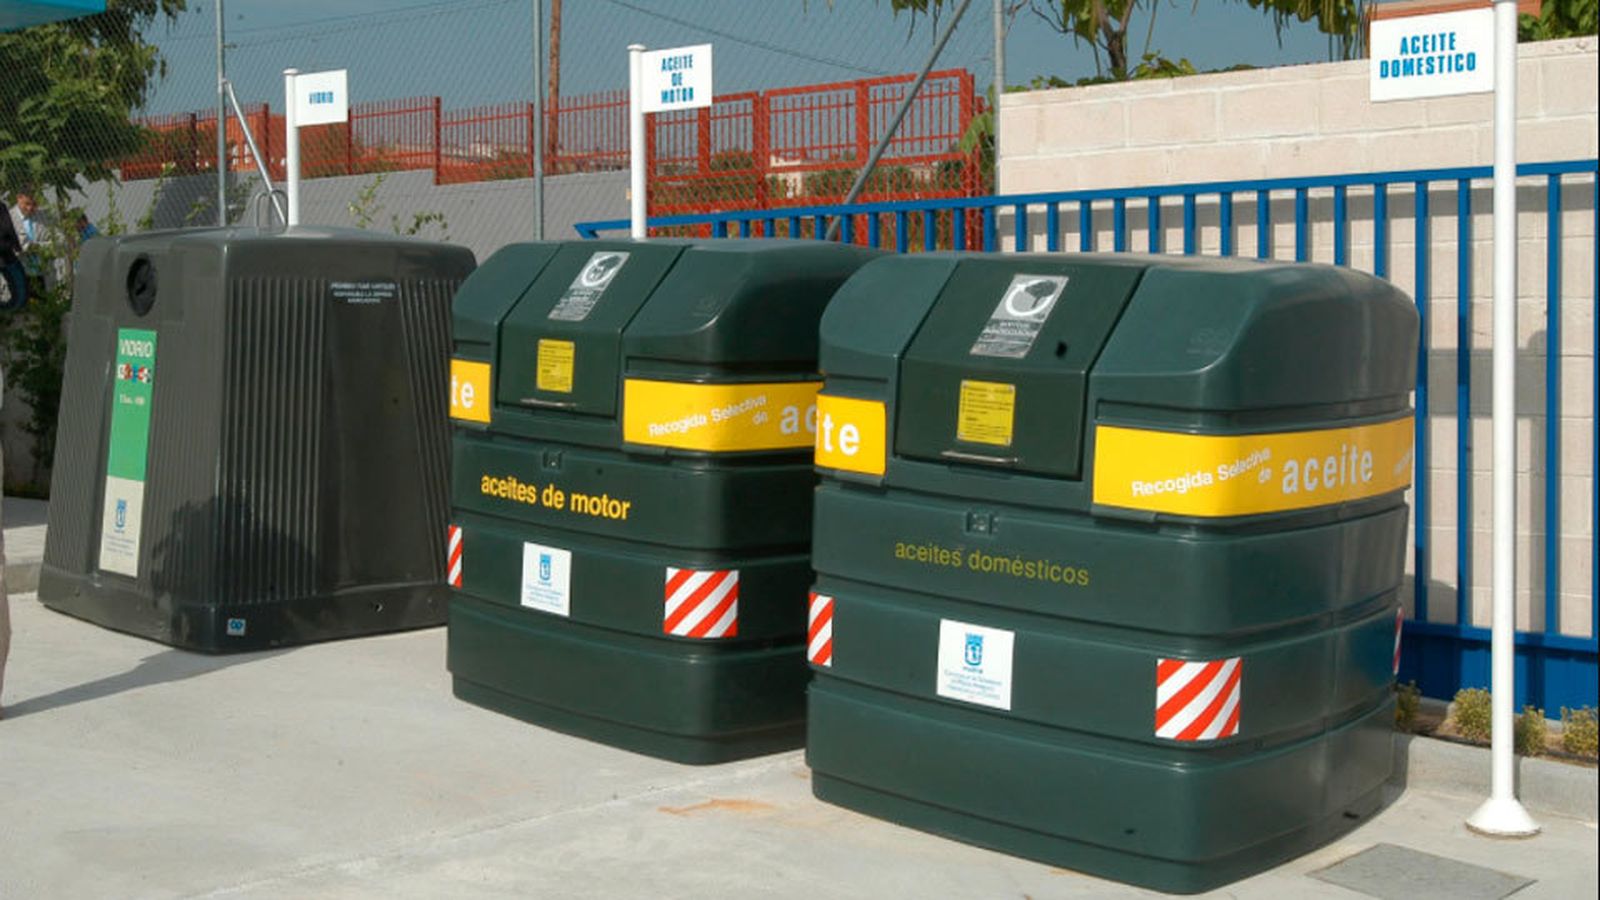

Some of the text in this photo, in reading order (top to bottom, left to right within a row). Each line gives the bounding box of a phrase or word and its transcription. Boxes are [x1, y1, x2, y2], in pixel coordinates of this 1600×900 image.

[1400, 32, 1456, 55] ACEITE
[661, 54, 693, 71] ACEITE
[1380, 52, 1476, 78] DOMESTICO
[671, 72, 682, 86] DE
[661, 87, 694, 104] MOTOR
[120, 339, 154, 358] VIDRIO
[648, 395, 767, 437] Recogida Selectiva
[753, 411, 768, 425] de
[822, 411, 861, 457] te
[1131, 447, 1272, 497] Recogida Selectiva
[1258, 467, 1272, 483] de
[1282, 444, 1374, 494] aceite
[480, 474, 631, 520] aceites de motor
[895, 541, 1090, 586] aceites domésticos
